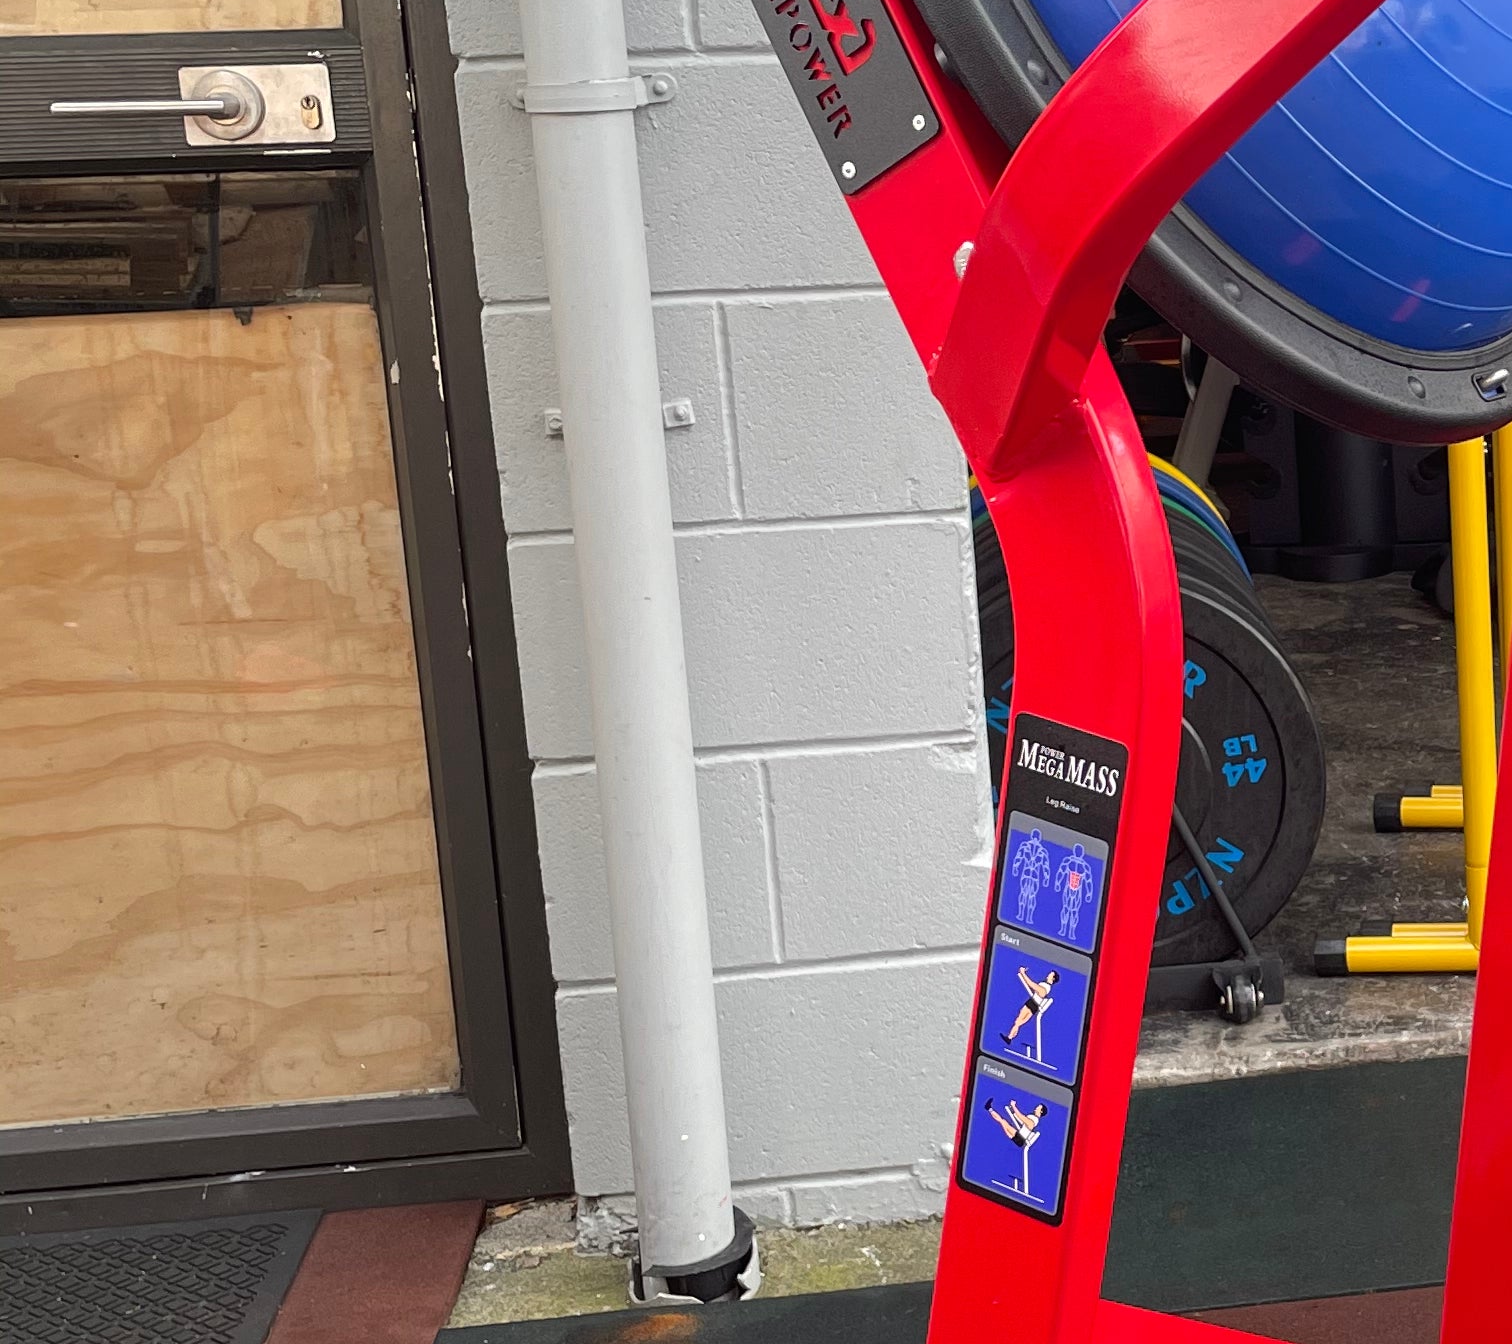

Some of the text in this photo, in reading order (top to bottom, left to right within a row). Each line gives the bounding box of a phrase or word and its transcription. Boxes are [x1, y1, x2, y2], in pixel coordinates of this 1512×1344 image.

[1040, 744, 1065, 762] POWER
[1017, 738, 1120, 797] MEGA MASS
[1046, 796, 1060, 809] Leg
[1000, 932, 1021, 947] Start
[983, 1064, 1006, 1079] Finish
